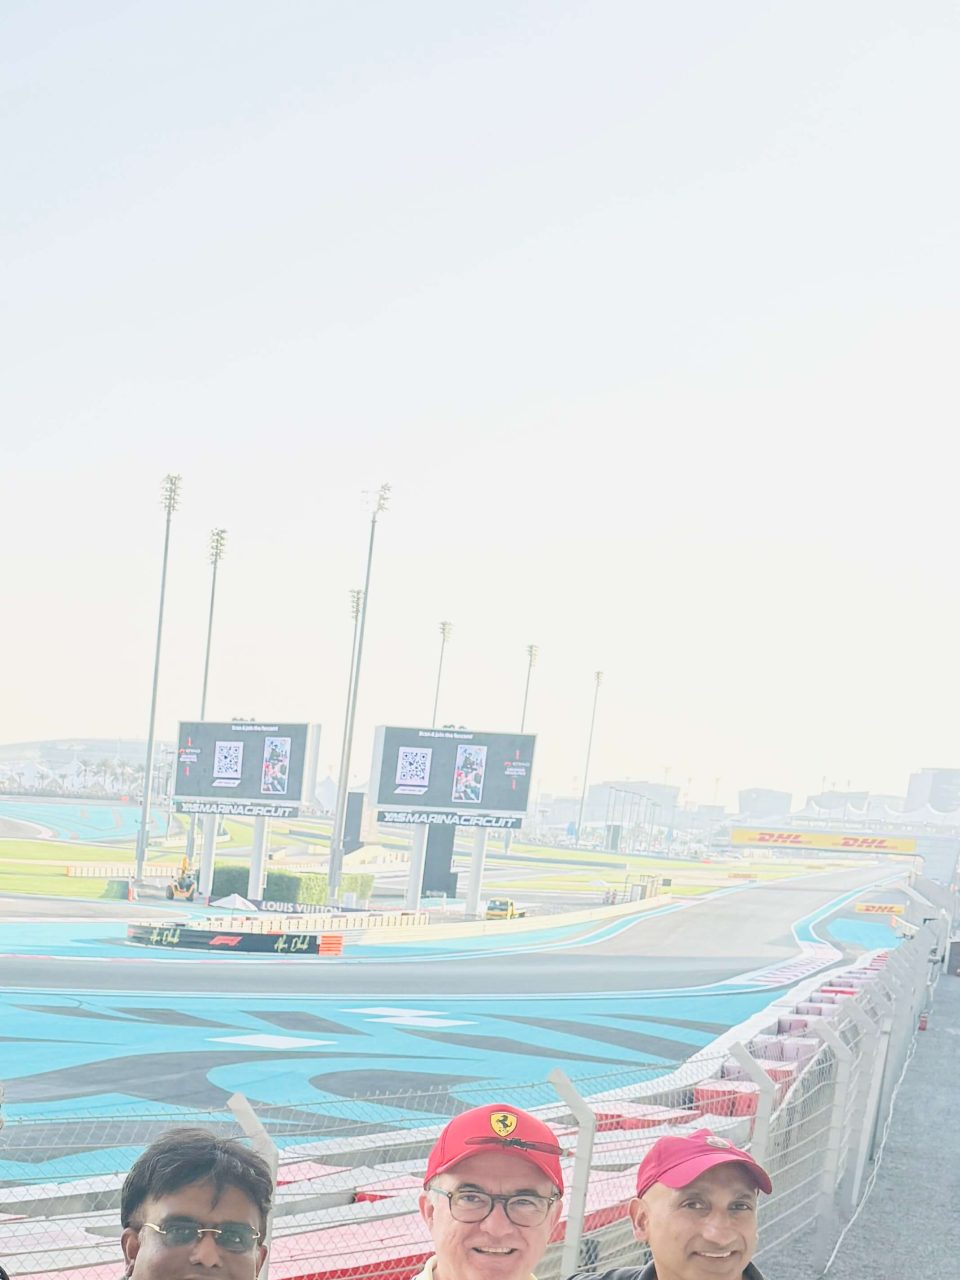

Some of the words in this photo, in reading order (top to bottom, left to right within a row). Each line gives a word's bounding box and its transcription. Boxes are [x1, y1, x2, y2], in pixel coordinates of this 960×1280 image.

[757, 832, 802, 844] DHL
[841, 837, 888, 849] DHL
[262, 901, 294, 912] LOUIS
